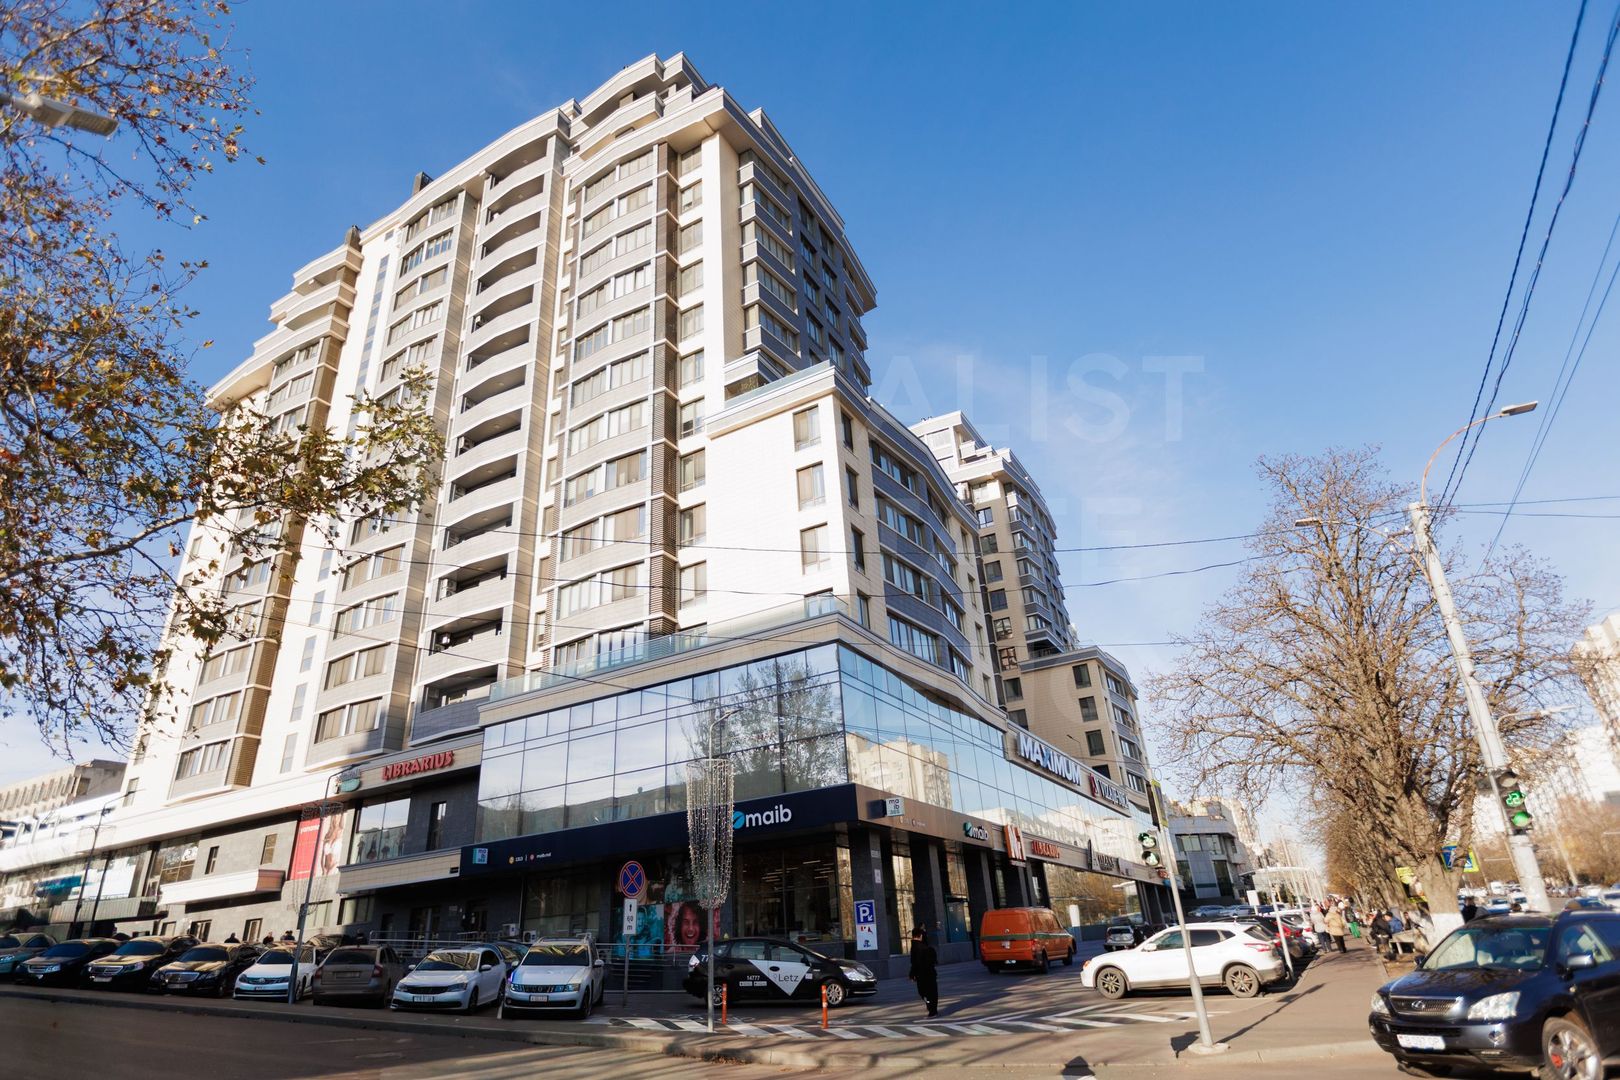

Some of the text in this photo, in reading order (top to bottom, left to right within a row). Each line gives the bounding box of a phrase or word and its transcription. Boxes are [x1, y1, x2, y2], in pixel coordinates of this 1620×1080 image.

[381, 750, 454, 781] LIBRARIUS
[1018, 731, 1082, 786] MAXIMUM
[745, 805, 792, 827] maib
[972, 826, 990, 841] maib
[859, 906, 870, 922] P
[778, 973, 799, 982] Letz
